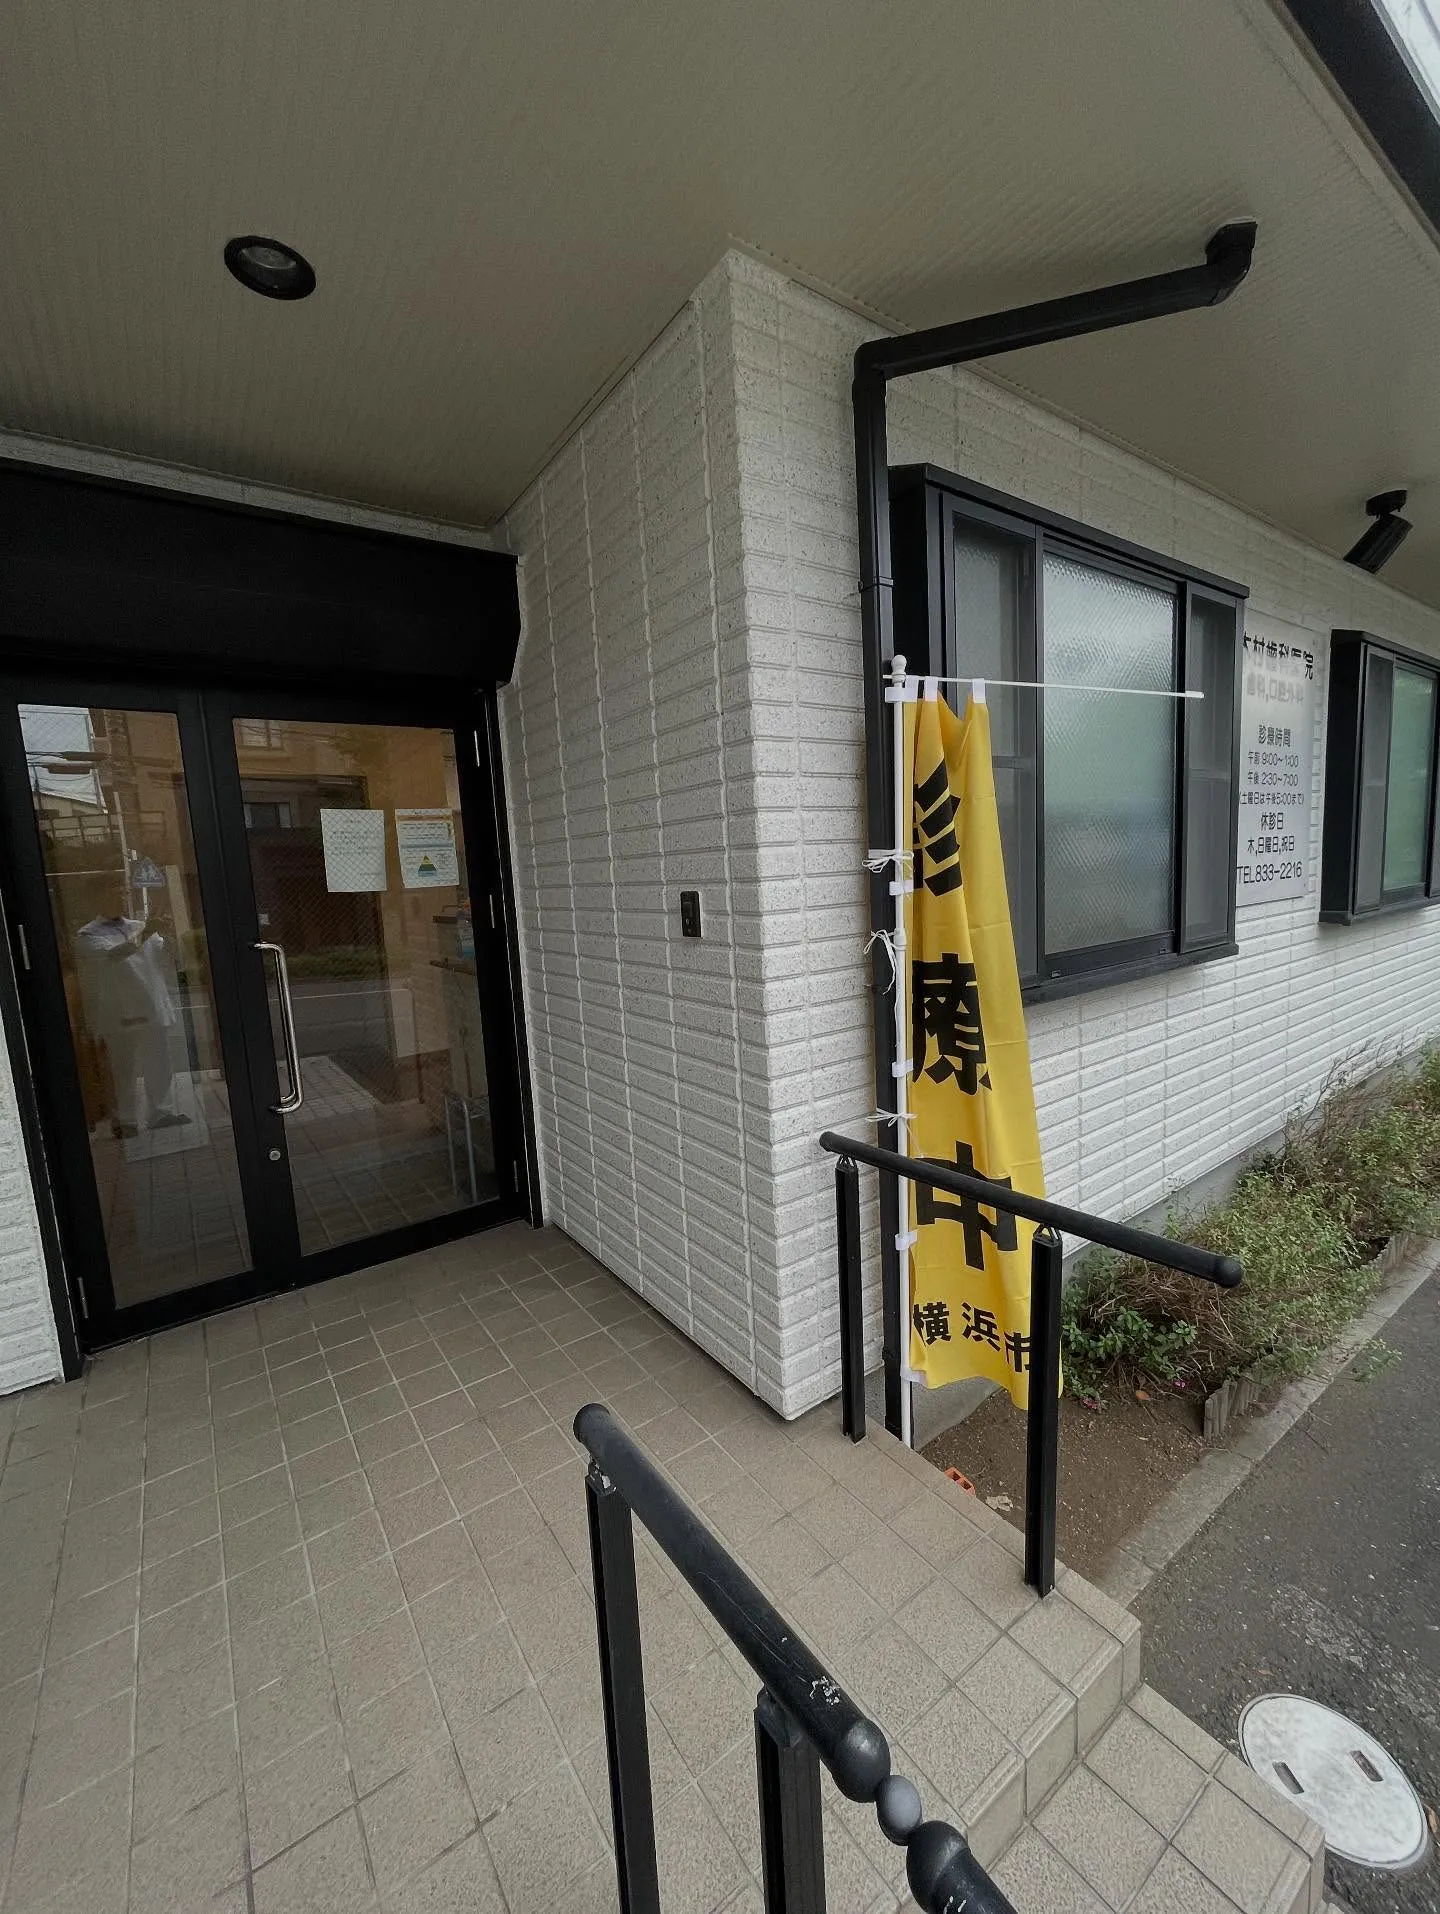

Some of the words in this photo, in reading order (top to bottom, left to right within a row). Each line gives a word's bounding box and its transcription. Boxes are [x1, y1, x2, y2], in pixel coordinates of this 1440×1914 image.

[1258, 724, 1291, 748] 診療時間
[1247, 748, 1259, 765] 午前
[1247, 769, 1259, 785] 午後
[1260, 811, 1284, 832] 休診日
[912, 1301, 1033, 1374] 横浜市
